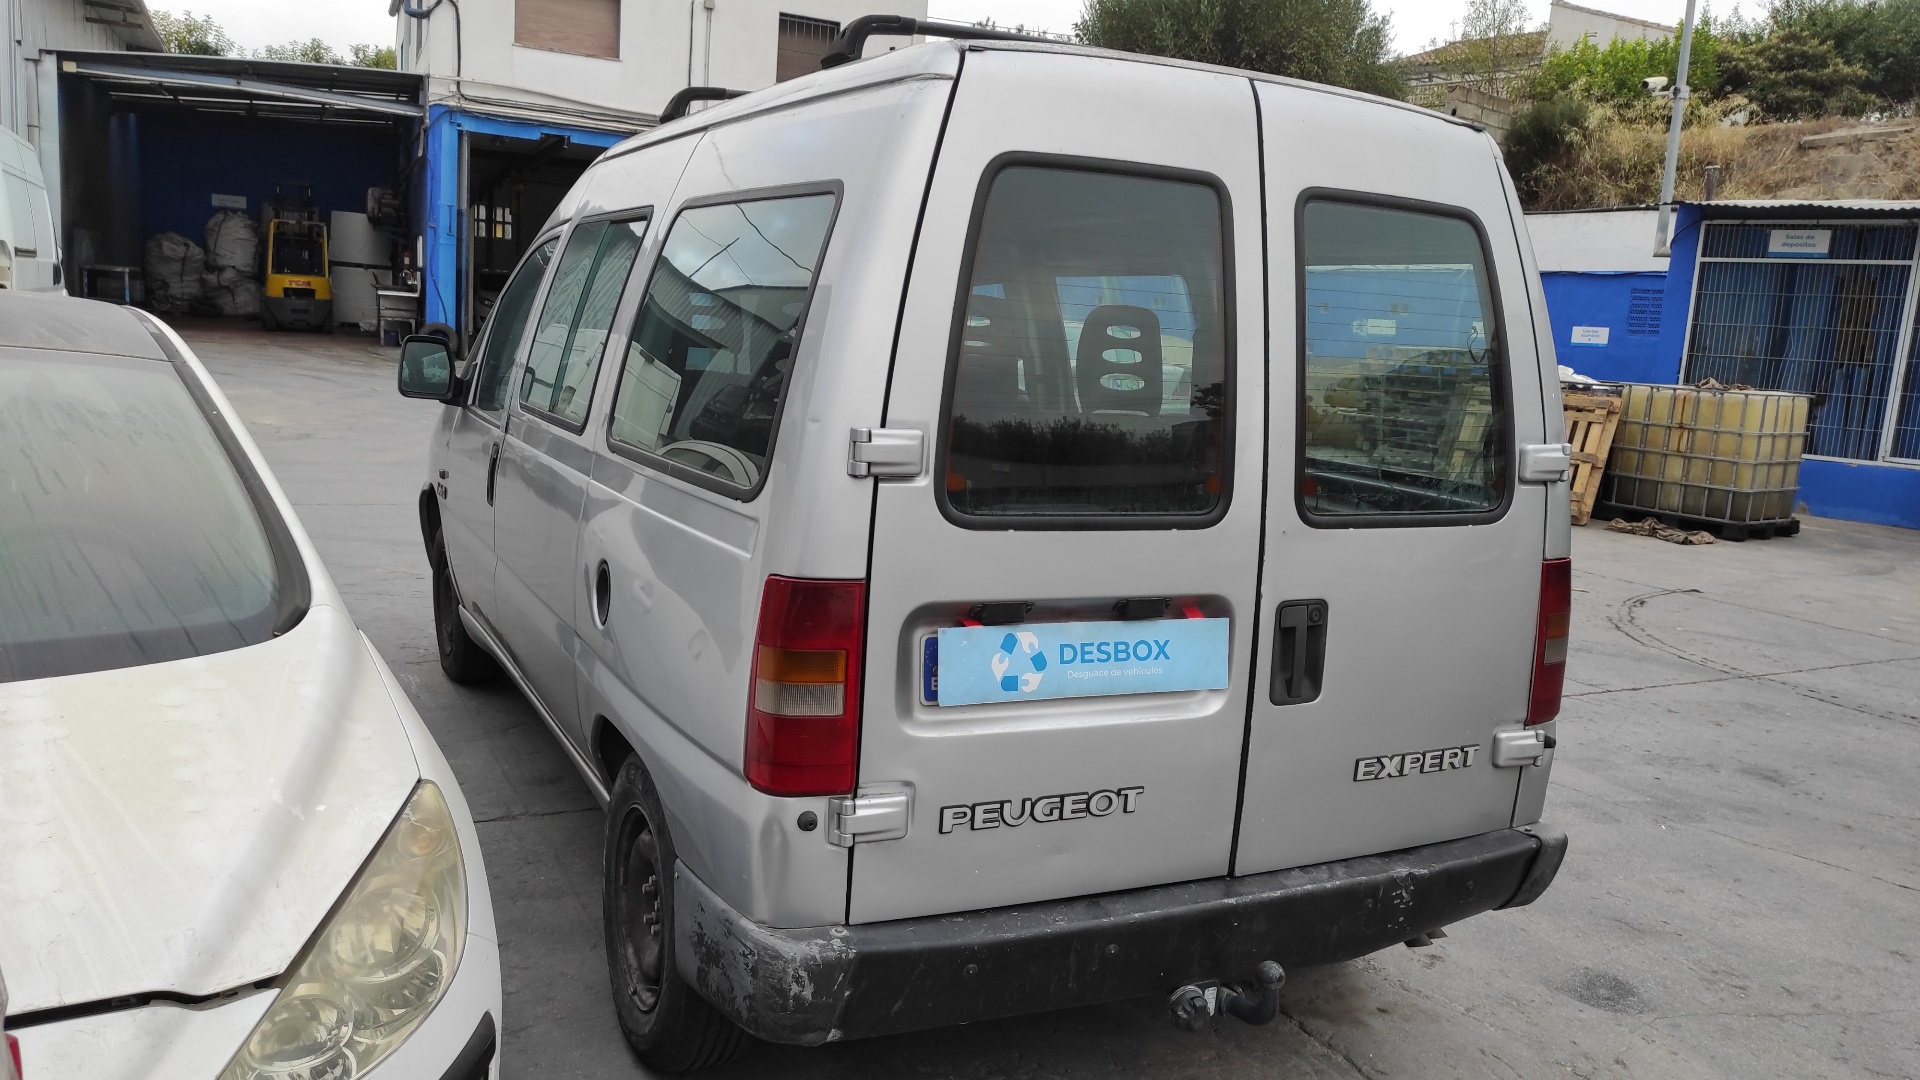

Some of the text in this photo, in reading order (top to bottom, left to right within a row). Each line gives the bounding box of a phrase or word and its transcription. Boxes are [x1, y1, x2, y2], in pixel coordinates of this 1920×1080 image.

[1059, 639, 1171, 665] DESBOX
[1067, 667, 1163, 679] Desguace de vehículos
[1353, 744, 1480, 782] EXPERT
[939, 785, 1145, 834] PEUGEOT
